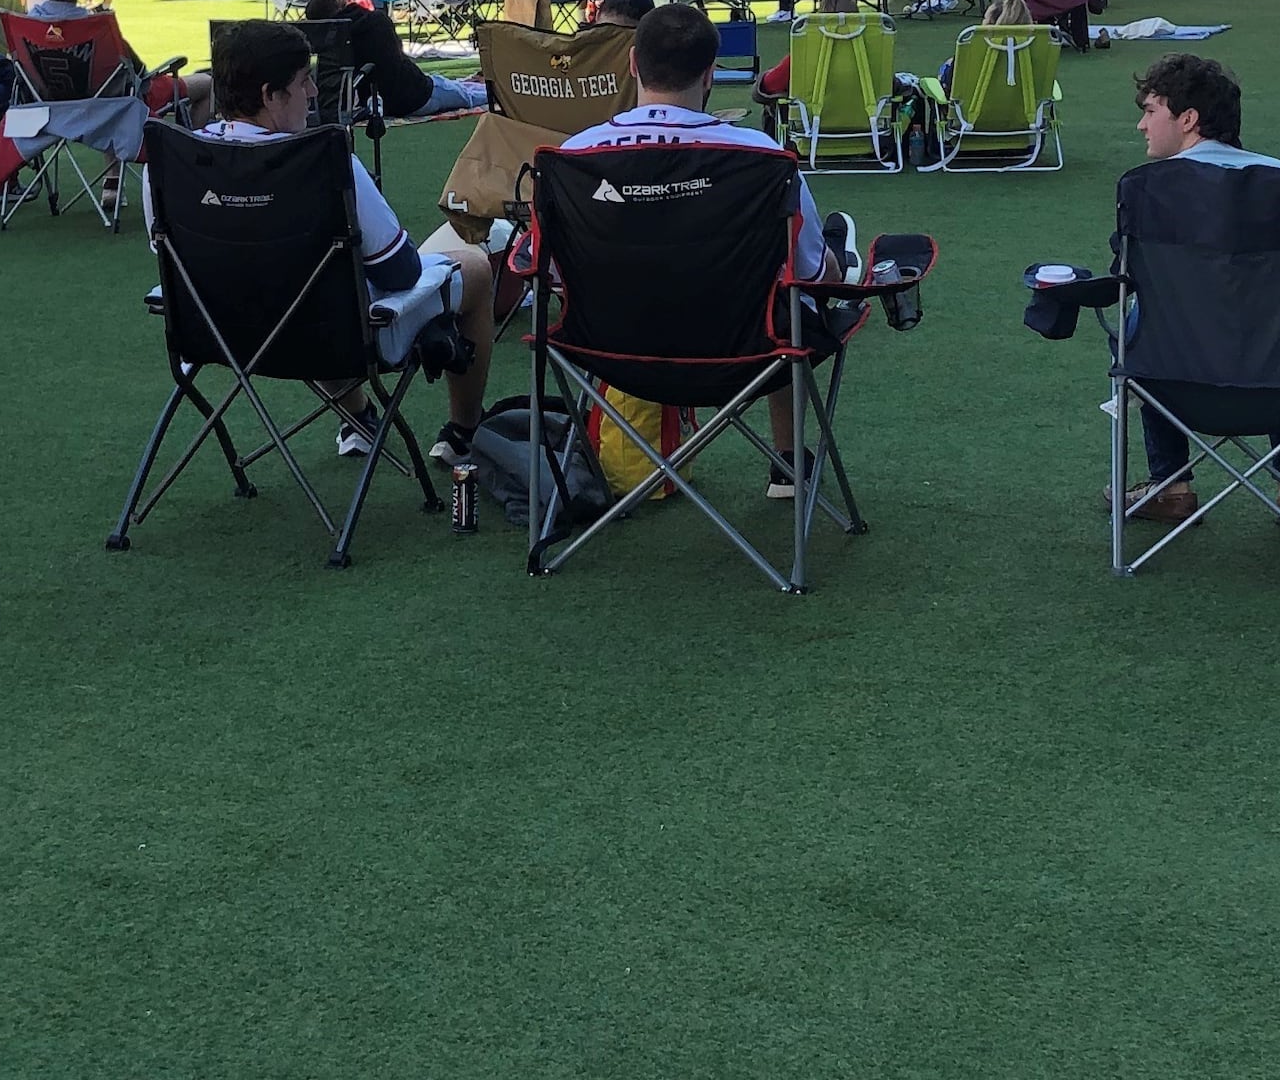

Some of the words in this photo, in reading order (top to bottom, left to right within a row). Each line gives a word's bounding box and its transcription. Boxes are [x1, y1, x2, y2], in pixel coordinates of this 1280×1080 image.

[510, 72, 575, 98] GEORGIA
[577, 72, 619, 98] TECH
[622, 183, 670, 197] OZARK
[671, 178, 712, 192] TRAIL
